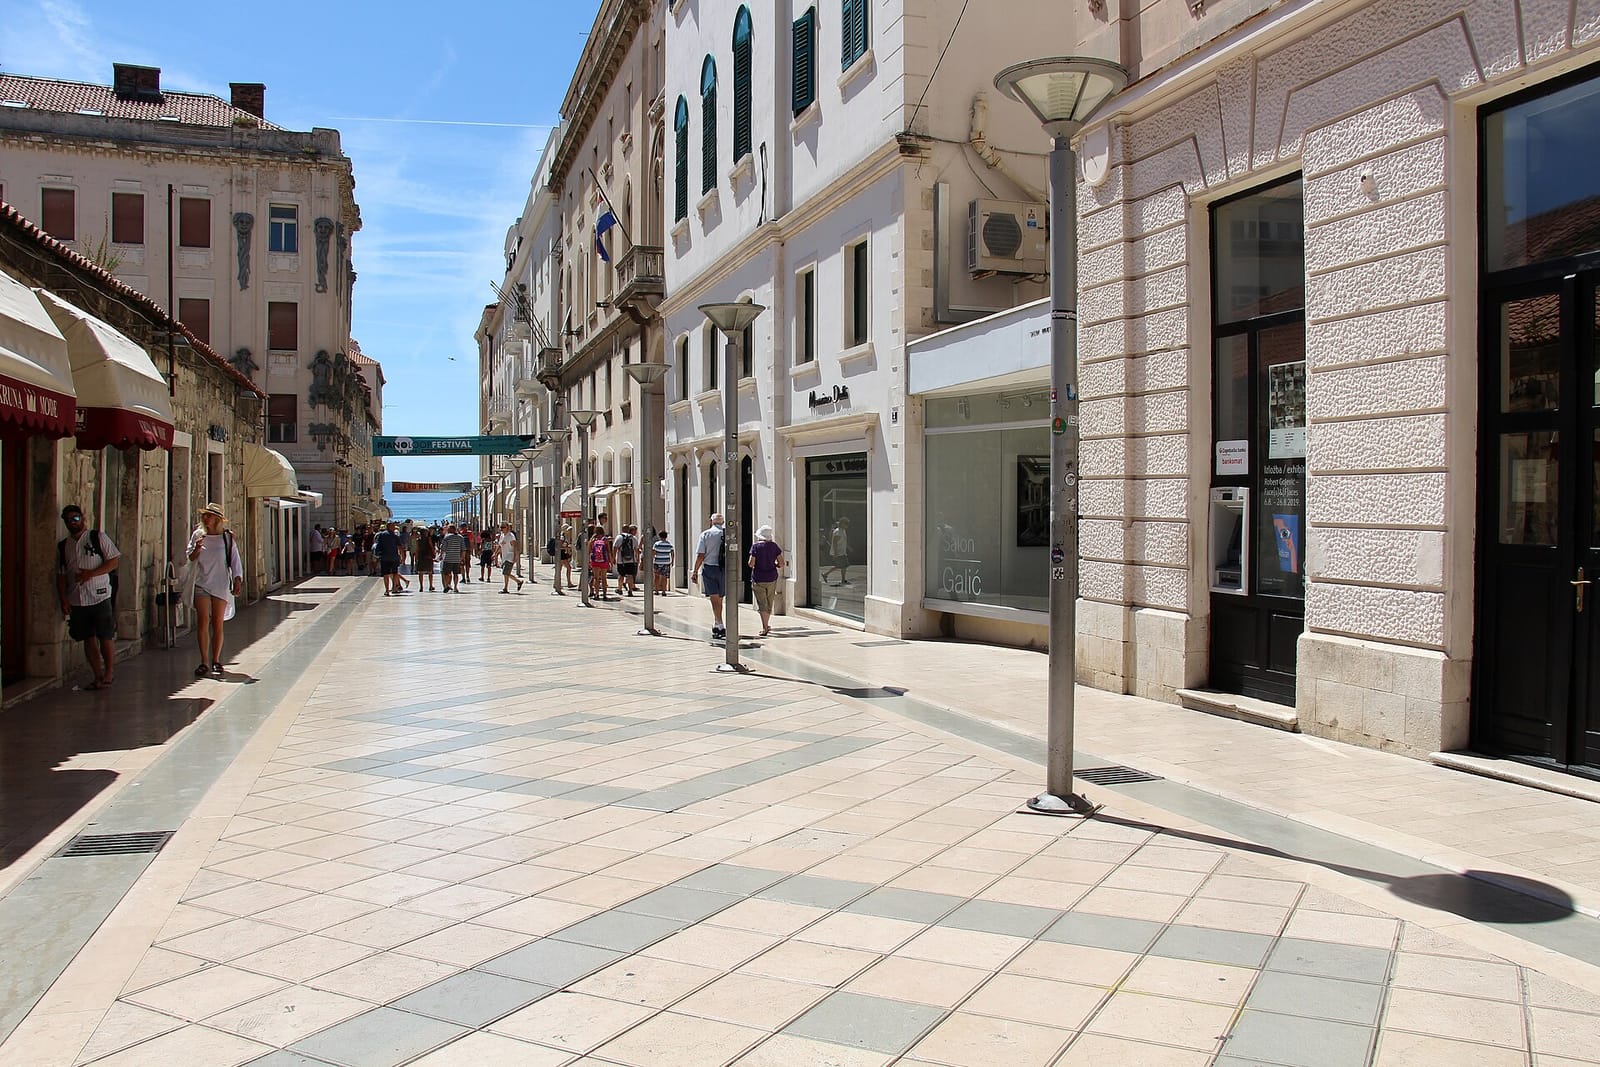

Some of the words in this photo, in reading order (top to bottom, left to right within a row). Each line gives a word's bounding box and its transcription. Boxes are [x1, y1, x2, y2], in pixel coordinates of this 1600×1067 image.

[432, 441, 472, 449] FESTIVAL
[944, 535, 976, 553] Salon
[943, 566, 982, 596] Galić
